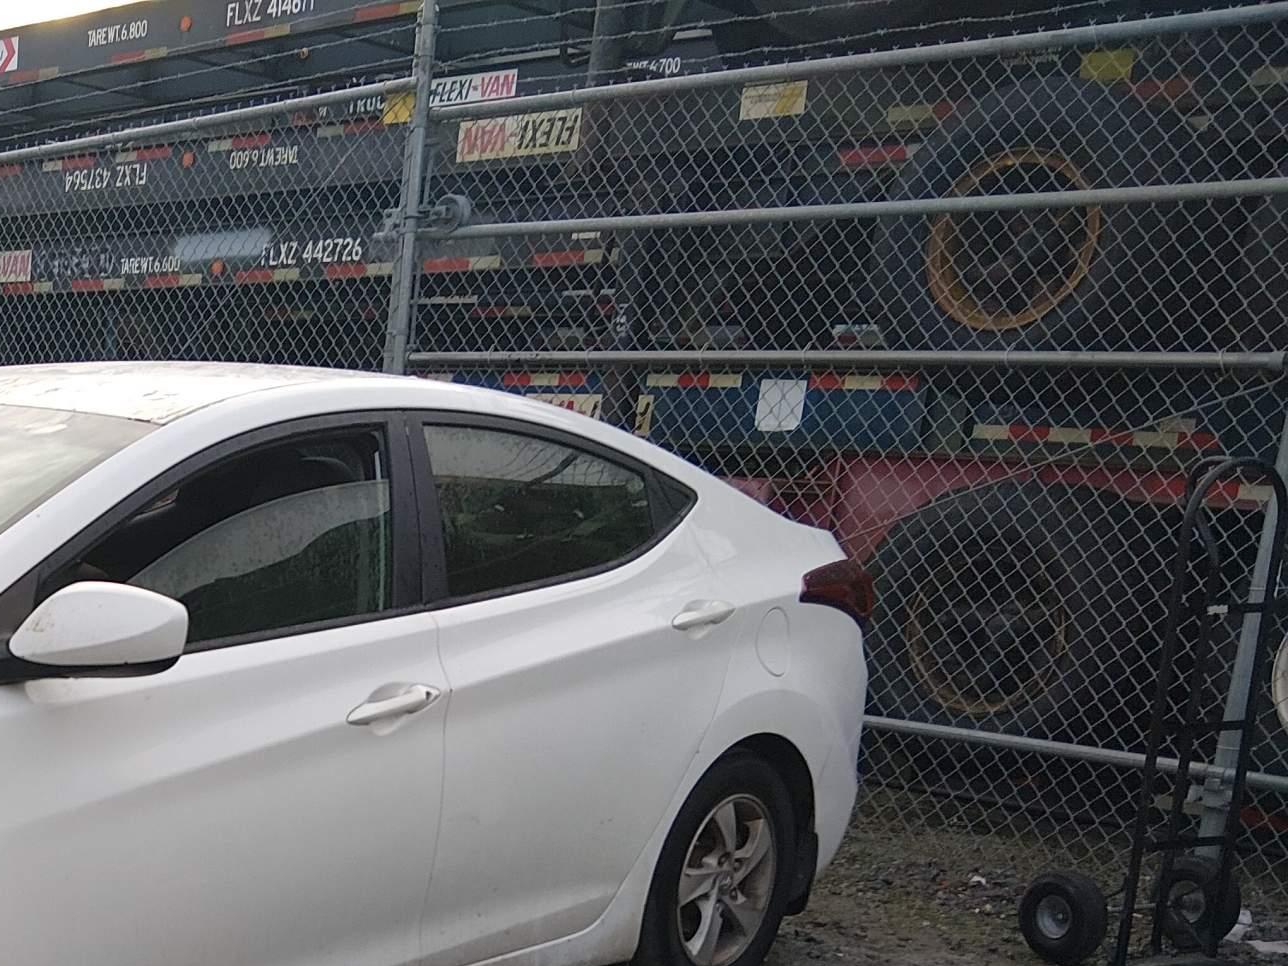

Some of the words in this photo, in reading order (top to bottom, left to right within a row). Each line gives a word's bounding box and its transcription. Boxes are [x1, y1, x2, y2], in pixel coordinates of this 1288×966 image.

[226, 0, 262, 27] FLXZ
[65, 167, 111, 193] 437564
[115, 162, 147, 187] FLXZ
[261, 240, 297, 267] FLXZ
[302, 237, 362, 264] 442726
